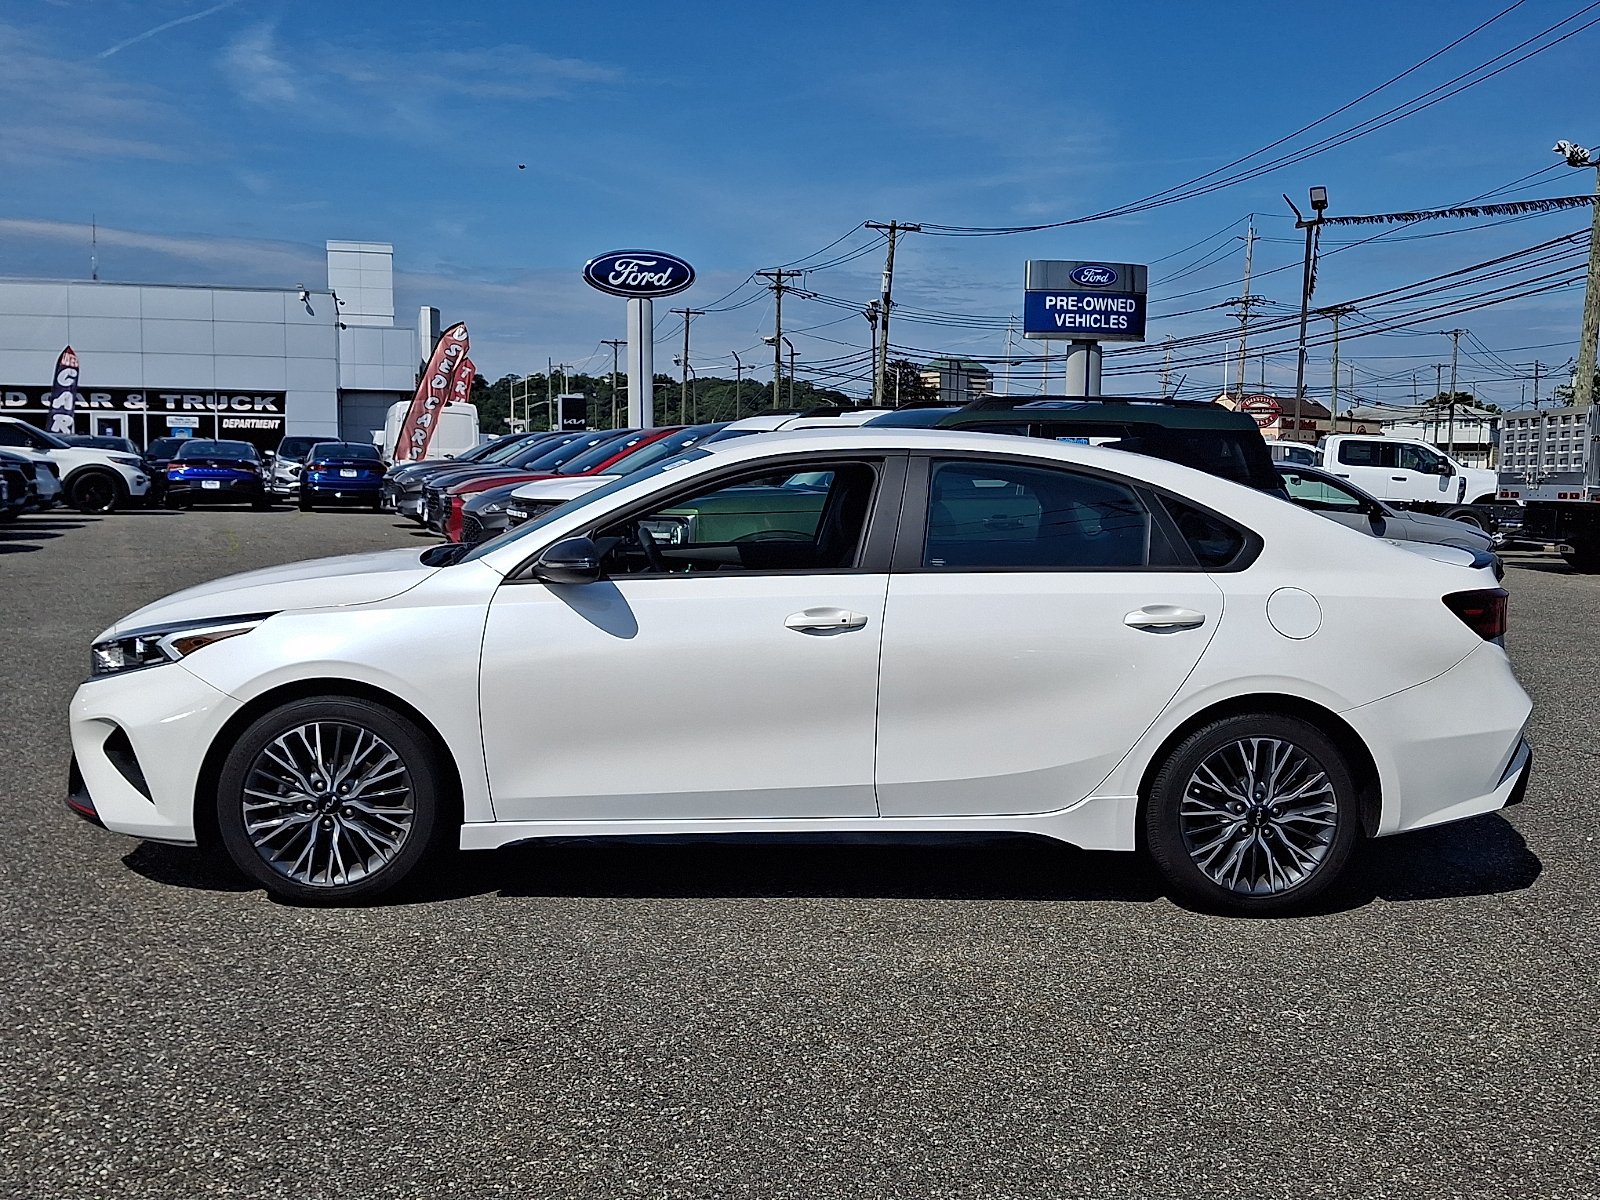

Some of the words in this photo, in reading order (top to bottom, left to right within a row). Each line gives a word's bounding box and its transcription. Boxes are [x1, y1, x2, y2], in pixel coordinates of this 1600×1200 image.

[608, 258, 673, 286] Ford
[1080, 268, 1110, 283] Ford
[1045, 296, 1136, 312] PRE-OWNED
[1055, 313, 1128, 329] VEHICLES
[430, 327, 468, 389] USED
[160, 394, 278, 411] TRUCK
[1245, 396, 1275, 406] BOSTON
[222, 418, 281, 429] DEPARTMENT
[407, 396, 440, 460] CARS
